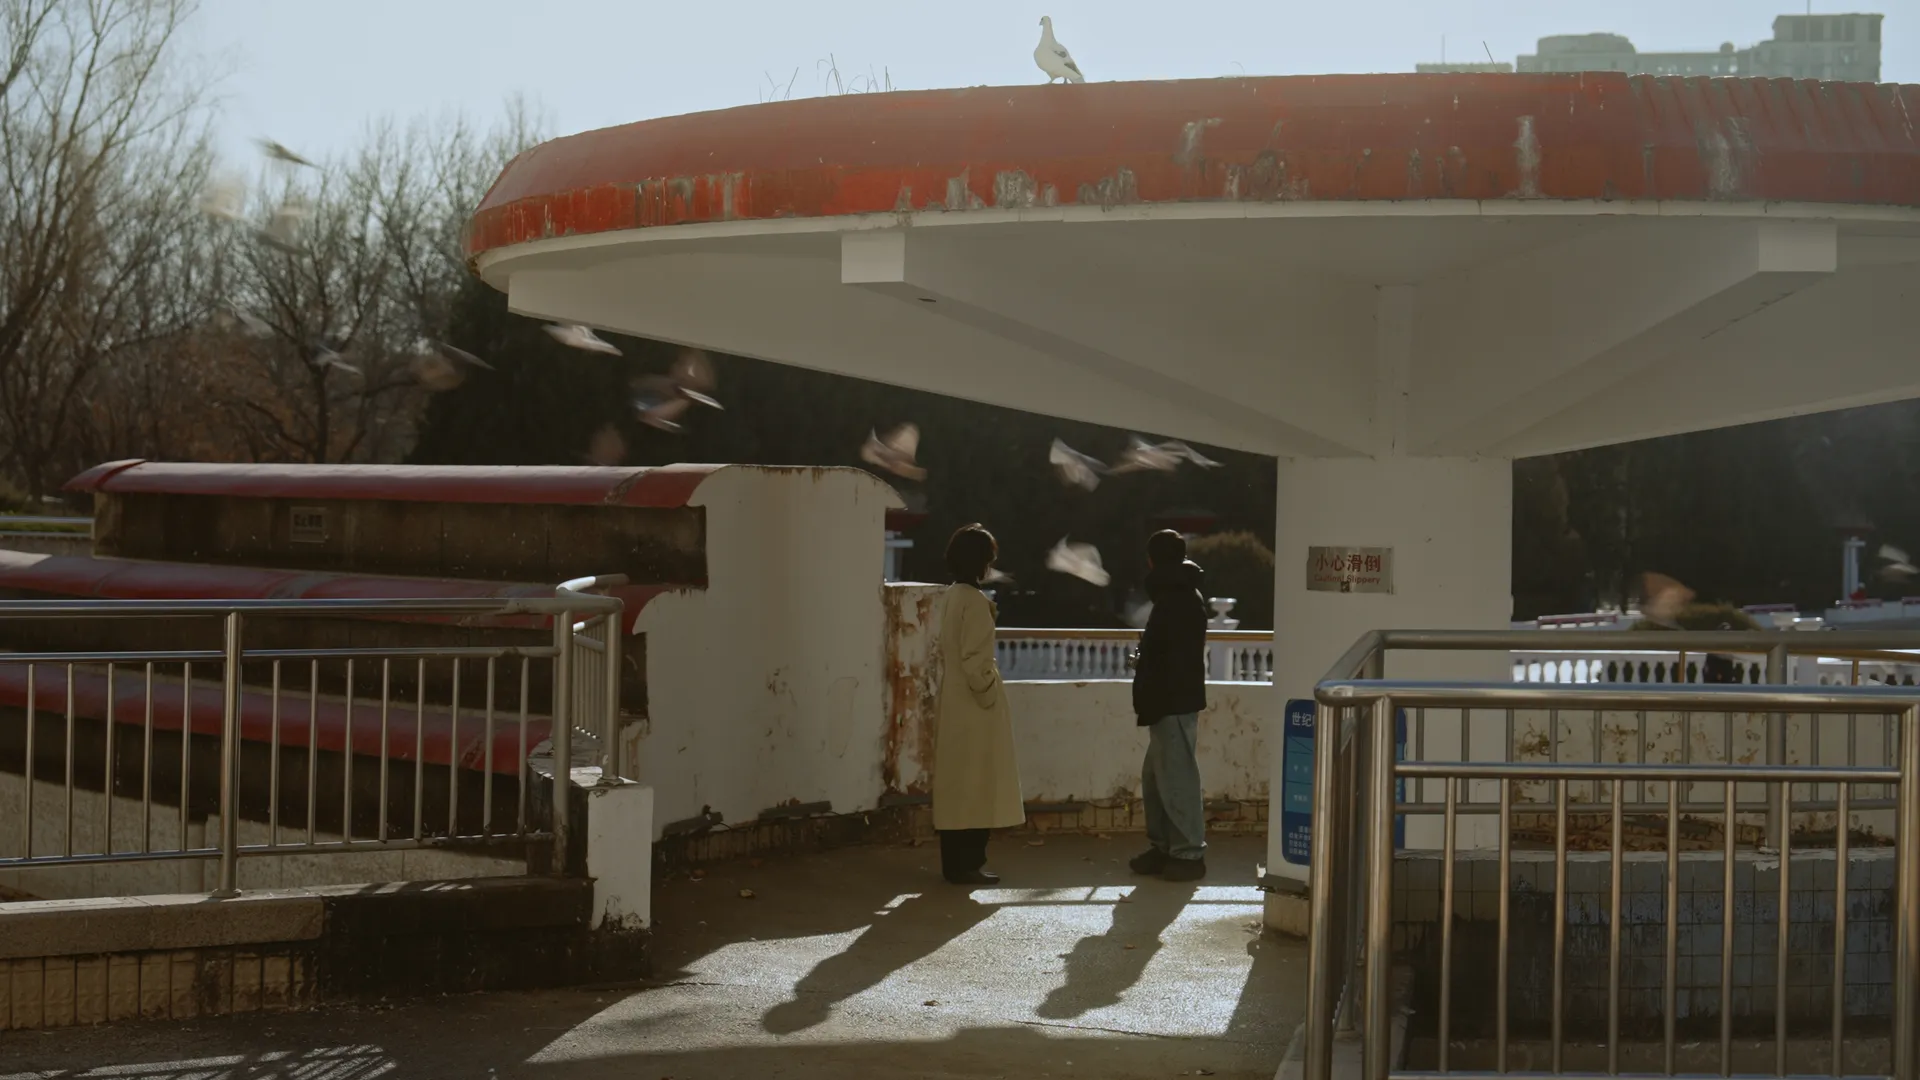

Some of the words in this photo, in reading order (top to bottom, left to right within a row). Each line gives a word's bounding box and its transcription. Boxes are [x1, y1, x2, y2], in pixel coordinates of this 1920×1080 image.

[1316, 554, 1381, 573] 小心滑倒
[1347, 575, 1381, 586] Slippery
[1292, 712, 1315, 727] 世纪
